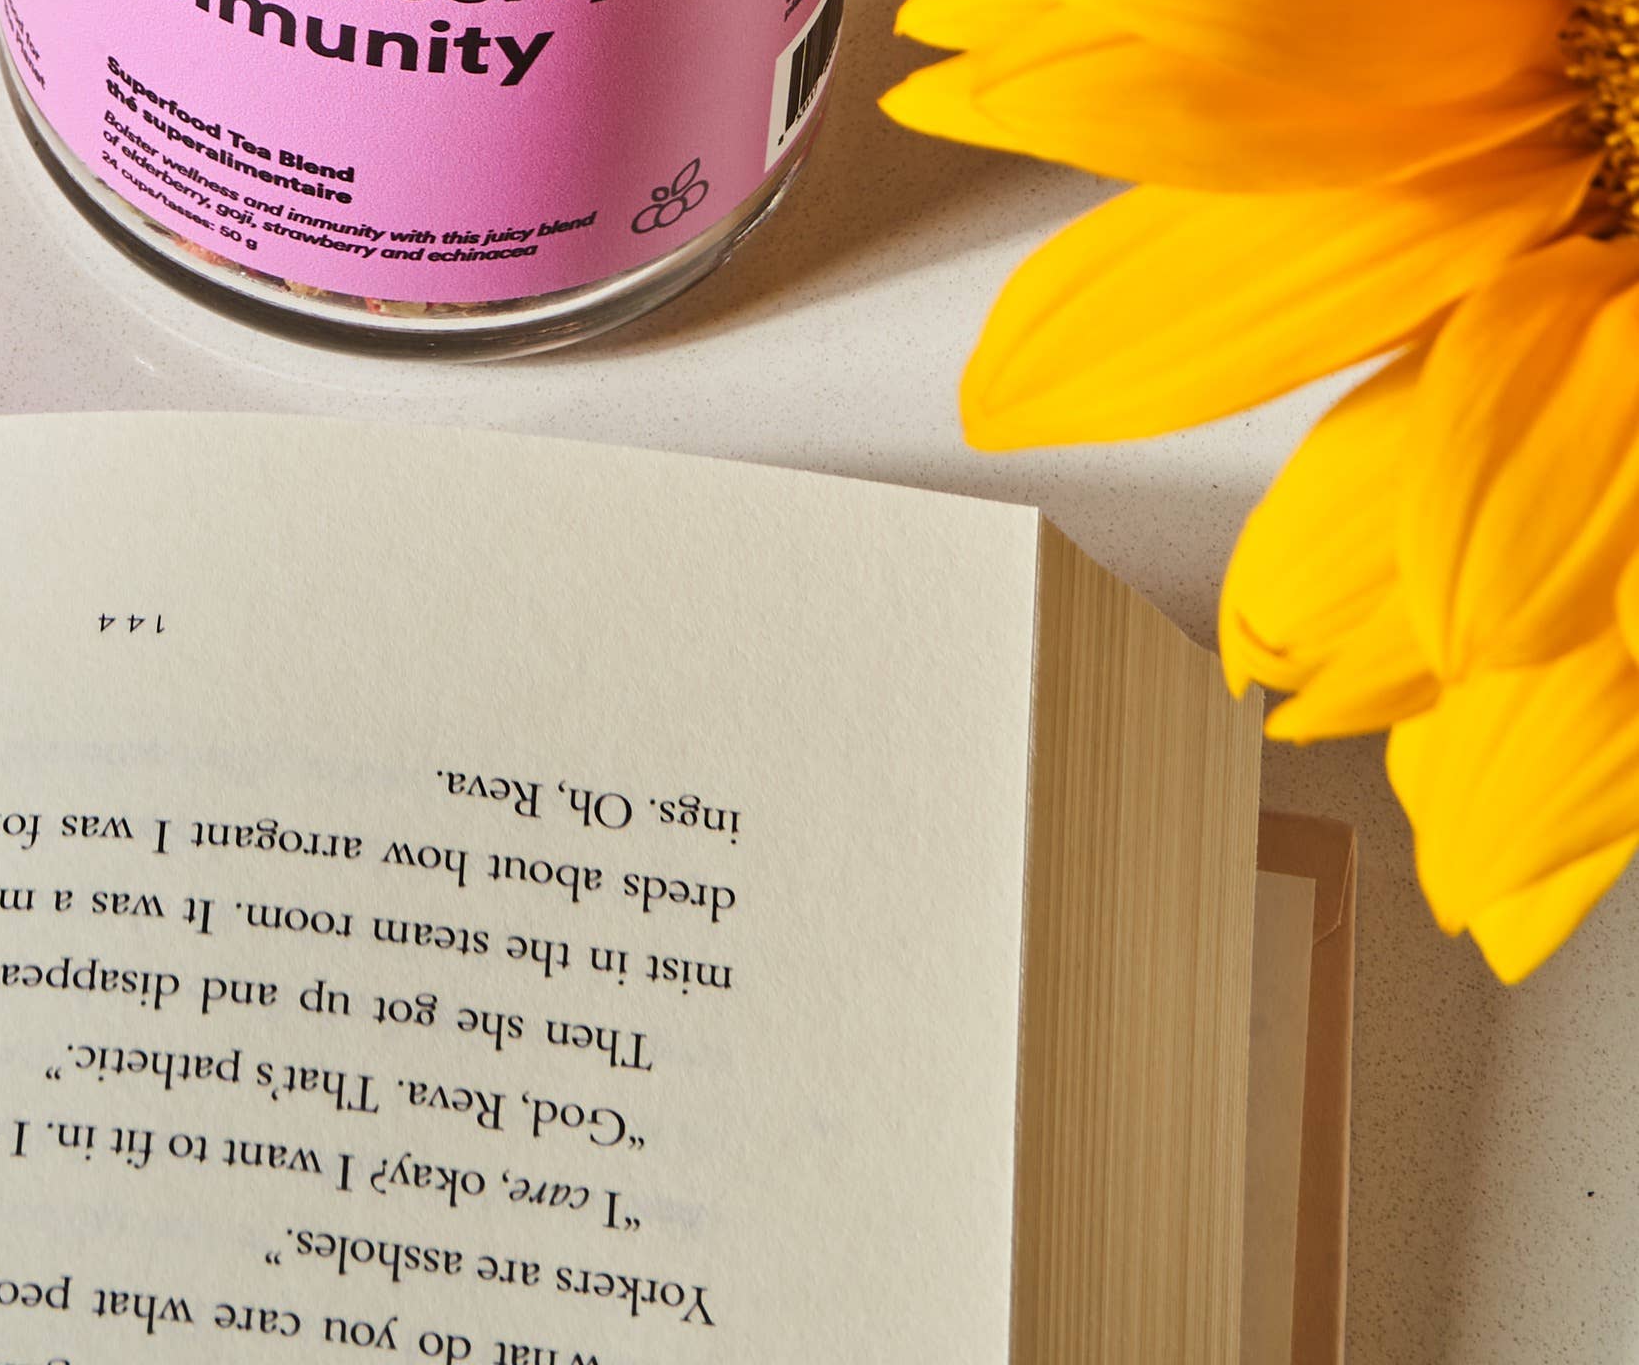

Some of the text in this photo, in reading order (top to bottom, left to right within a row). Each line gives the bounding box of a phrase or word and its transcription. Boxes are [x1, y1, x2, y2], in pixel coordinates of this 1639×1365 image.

[107, 56, 355, 183] Superfood Tea Blend
[106, 79, 353, 204] thé superalimentaire
[103, 130, 539, 263] of elderberry, goji, strawberry and echinacea
[104, 110, 598, 247] Bolster wellness and immunity with this juicy blend
[102, 150, 259, 251] 24 cups/tasses: 50 g
[61, 814, 134, 840] was
[436, 770, 741, 845] ings. Oh, Reva.
[190, 819, 363, 860] arrogant
[381, 841, 469, 889] how
[487, 854, 603, 904] about
[91, 891, 165, 918] was
[182, 897, 212, 935] It
[623, 873, 736, 924] dreds
[235, 902, 353, 938] room.
[373, 917, 489, 956] steam
[506, 935, 570, 979] the
[590, 947, 628, 986] in
[646, 954, 733, 996] mist
[201, 977, 278, 1016] and
[299, 979, 350, 1016] up
[373, 993, 438, 1027] got
[457, 1007, 524, 1052] she
[546, 1020, 653, 1072] Then
[397, 1079, 507, 1131] Reva.
[47, 1122, 96, 1161] in.
[110, 1127, 153, 1170] fit
[222, 1139, 323, 1174] want
[369, 1152, 486, 1208] okay?
[501, 1171, 590, 1210] care,
[476, 1255, 541, 1287] are
[92, 1289, 194, 1336] what
[556, 1267, 715, 1327] Yorkers
[214, 1303, 301, 1337] care
[324, 1316, 399, 1351] you
